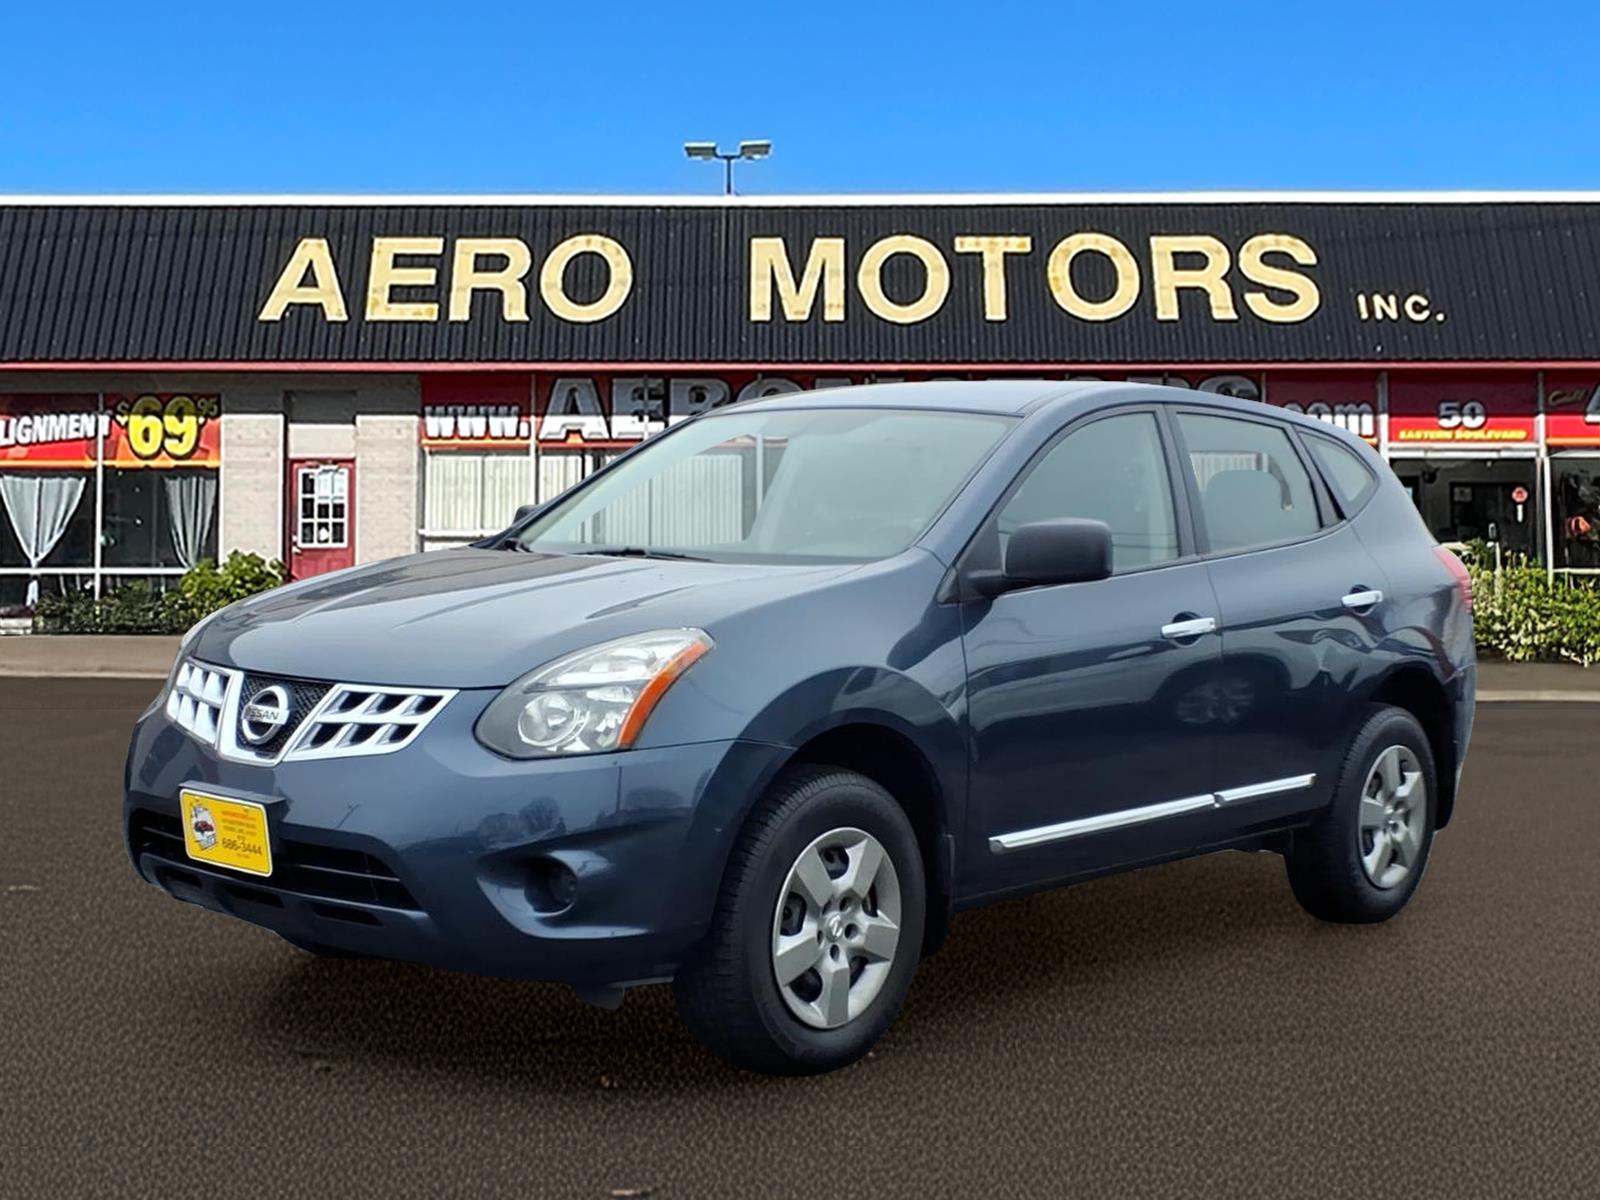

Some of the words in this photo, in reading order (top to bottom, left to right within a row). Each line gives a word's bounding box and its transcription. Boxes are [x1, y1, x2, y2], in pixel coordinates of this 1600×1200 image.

[258, 234, 633, 322] AERO
[750, 233, 1320, 325] MOTORS
[1357, 293, 1445, 321] INC.
[1438, 401, 1485, 428] 50
